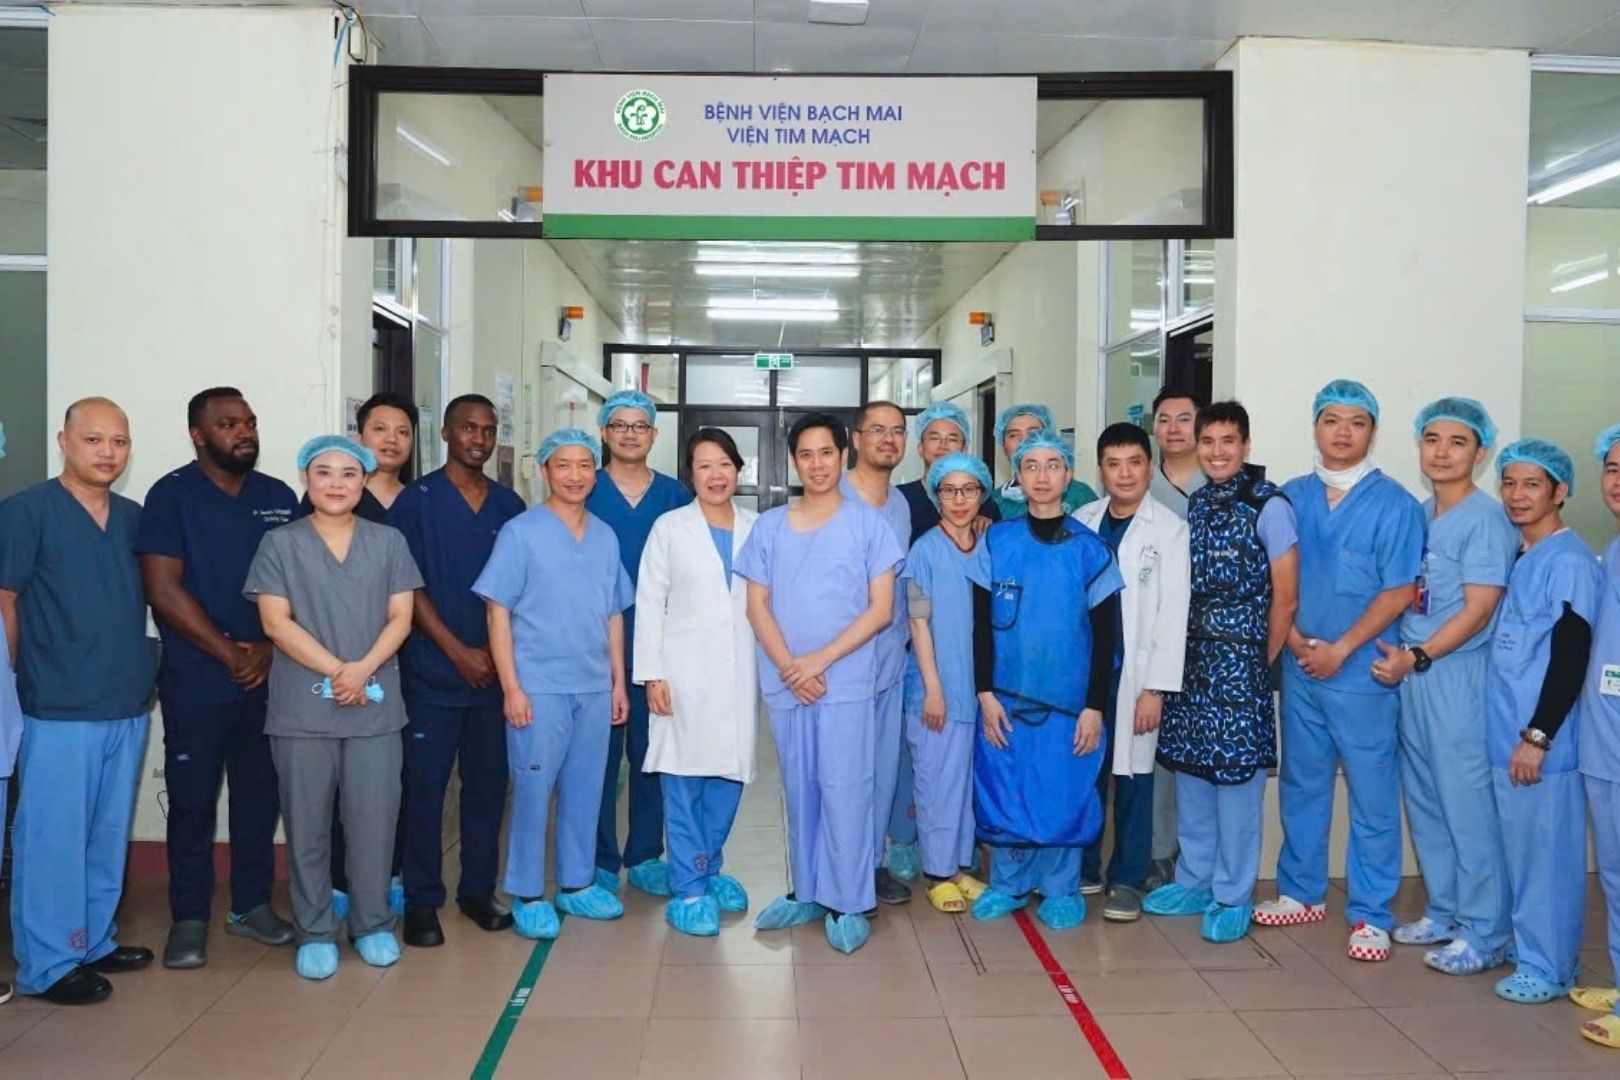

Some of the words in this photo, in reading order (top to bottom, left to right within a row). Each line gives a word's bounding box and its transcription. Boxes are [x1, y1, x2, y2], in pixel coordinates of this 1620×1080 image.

[704, 102, 753, 123] BỆNH
[758, 102, 800, 124] VIỆN
[807, 104, 860, 125] BẠCH
[866, 105, 904, 121] MAI
[727, 126, 769, 147] VIỆN
[775, 128, 806, 144] TIM
[811, 128, 871, 147] MẠCH
[574, 159, 643, 190] KHU
[652, 159, 722, 191] CAN
[732, 155, 828, 197] THIỆP
[837, 161, 897, 191] TIM
[906, 160, 1007, 197] MẠCH
